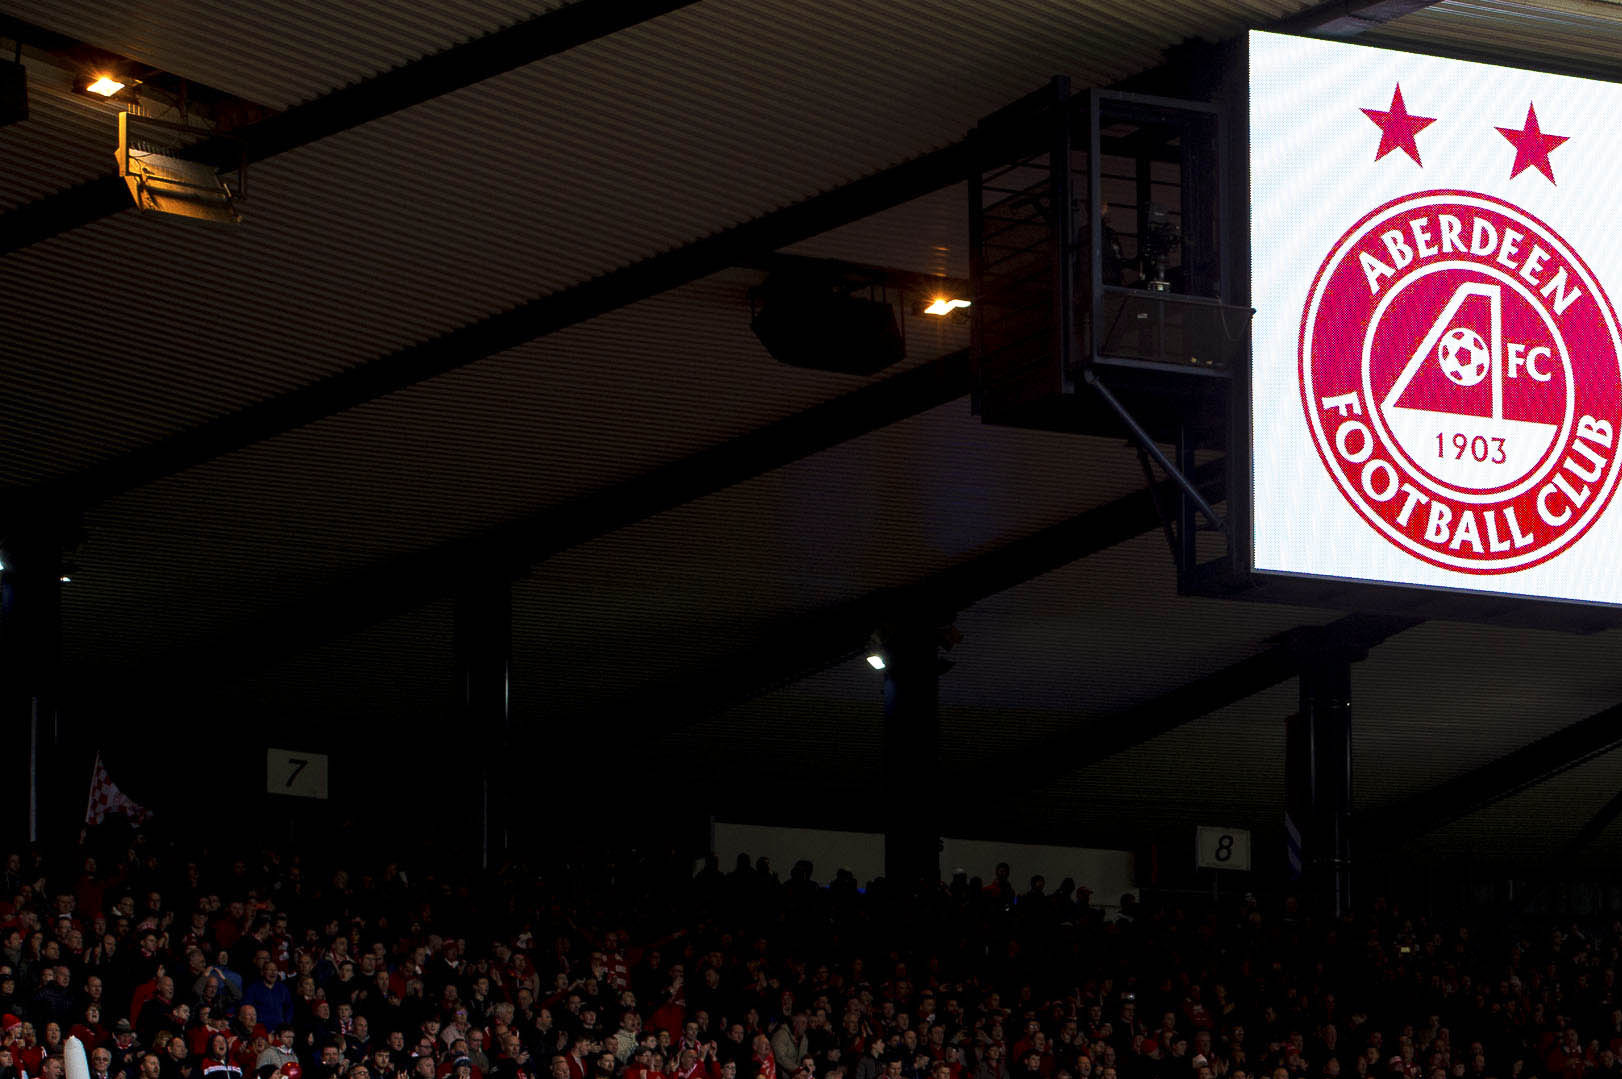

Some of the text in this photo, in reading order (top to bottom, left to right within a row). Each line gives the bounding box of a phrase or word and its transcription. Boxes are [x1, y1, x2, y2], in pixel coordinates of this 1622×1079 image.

[1357, 213, 1583, 317] ABERDEEN
[1506, 342, 1552, 382] FC
[1434, 431, 1507, 465] 1903
[1321, 390, 1614, 555] FOOTBALL CLUB
[285, 758, 308, 788] 7
[1214, 834, 1234, 862] 8
